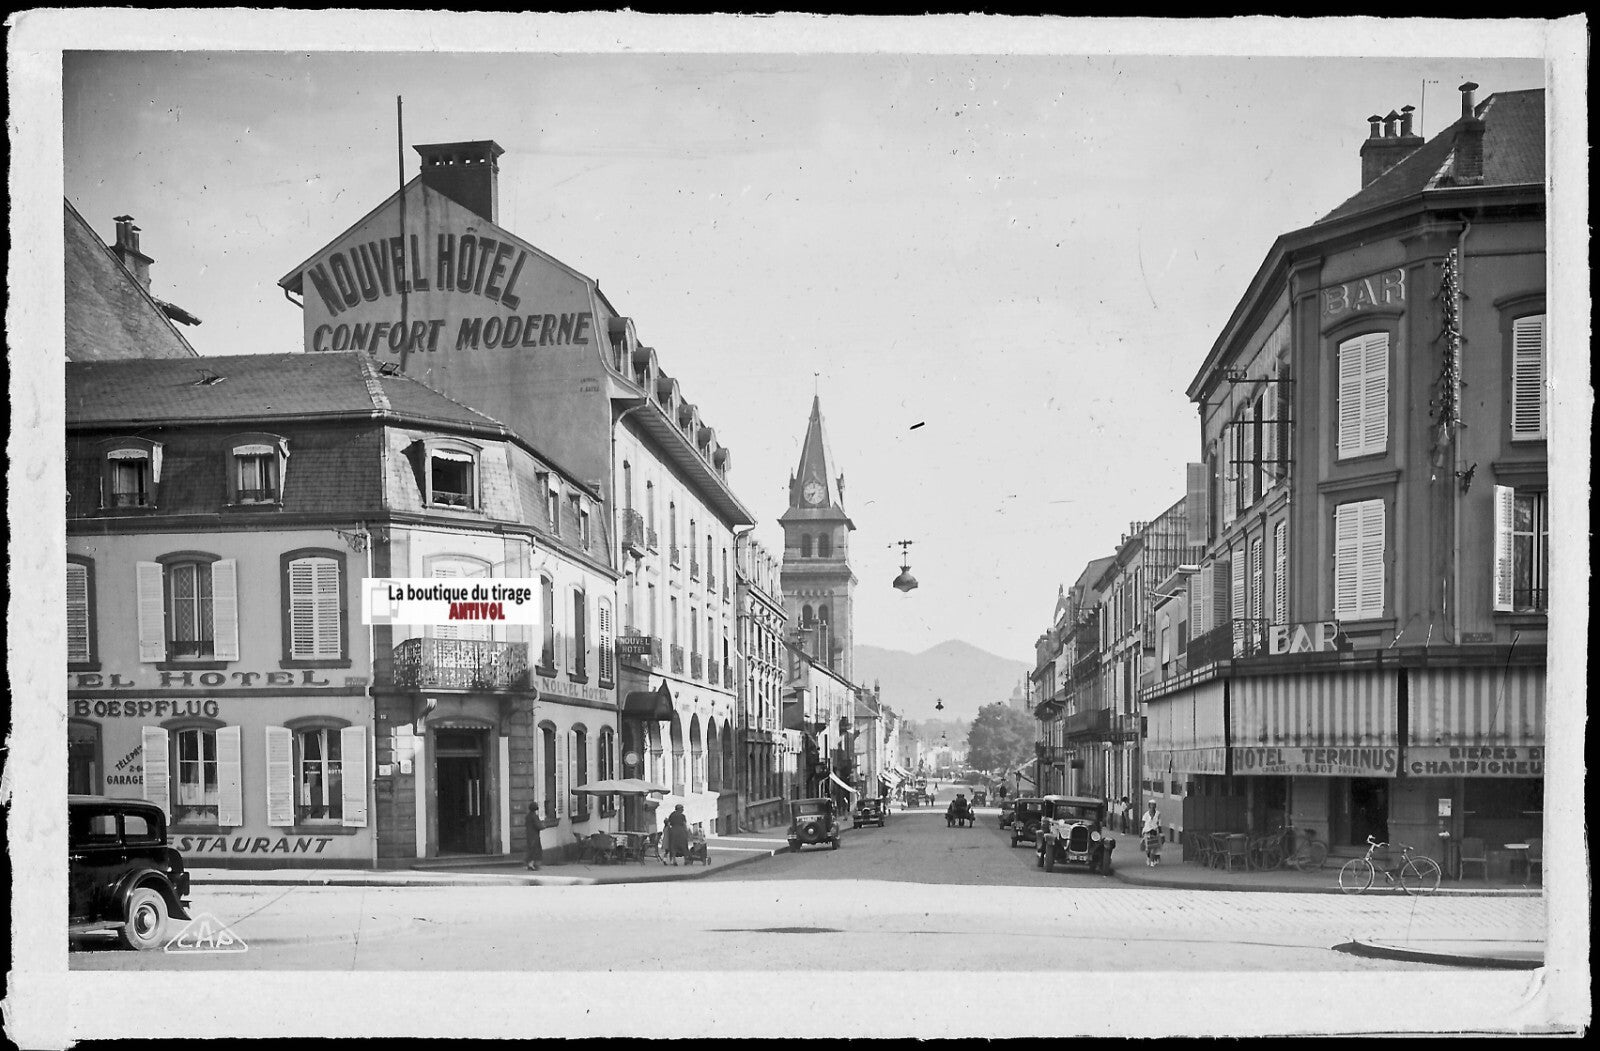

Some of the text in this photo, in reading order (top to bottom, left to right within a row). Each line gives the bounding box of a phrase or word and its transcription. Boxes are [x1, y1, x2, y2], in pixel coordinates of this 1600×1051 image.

[307, 227, 529, 317] NOUVEL HÔTEL
[1323, 268, 1406, 317] BAR
[312, 312, 593, 354] CONFORT MODERNE
[619, 637, 650, 646] NOUVEL
[1269, 620, 1340, 655] BAR
[68, 674, 136, 688] EL
[159, 669, 331, 688] HOTEL
[542, 677, 609, 703] NOUVEL HOTEL
[74, 699, 220, 719] BOESPFLUG
[1236, 748, 1285, 771] HOTEL
[1302, 747, 1396, 773] TERMINUS
[1449, 747, 1543, 759] BIERES D
